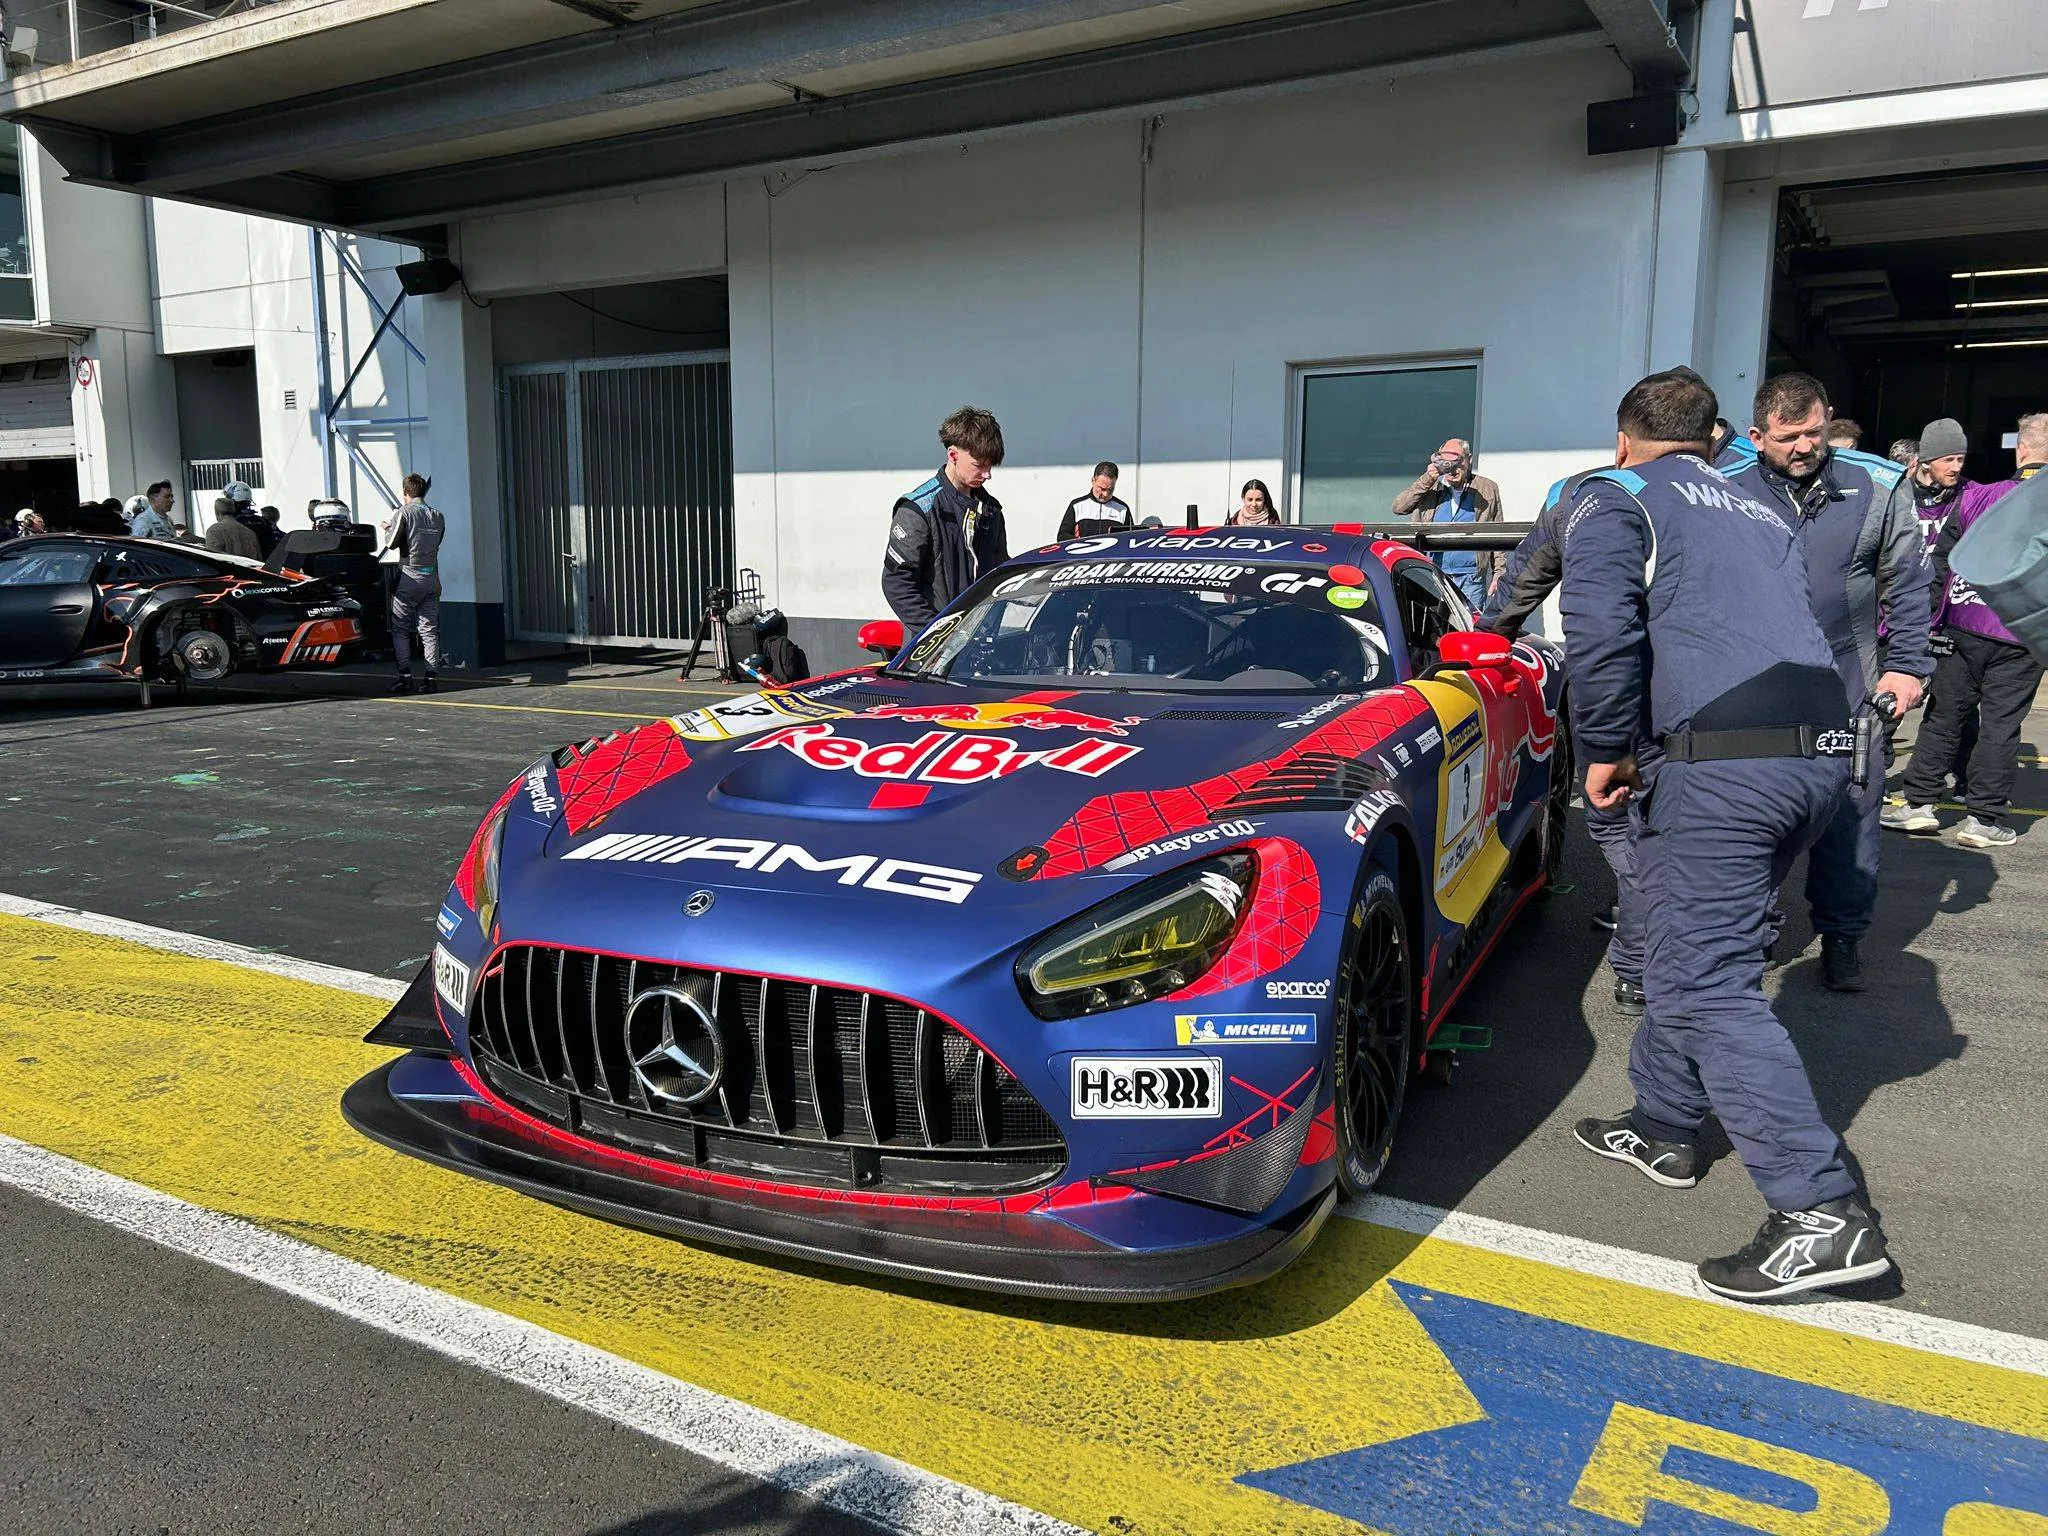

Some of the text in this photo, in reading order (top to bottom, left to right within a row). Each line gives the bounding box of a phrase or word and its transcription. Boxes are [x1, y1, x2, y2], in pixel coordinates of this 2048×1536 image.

[1127, 535, 1293, 553] viaplay
[1050, 564, 1126, 582] GRAN
[1072, 577, 1103, 587] REAL
[1104, 577, 1155, 585] DRIVING
[1156, 577, 1231, 588] SIMULATOR
[910, 615, 963, 661] 3
[734, 722, 942, 780] Red
[1463, 762, 1471, 821] 3
[1344, 789, 1409, 845] FALKE
[1134, 827, 1221, 863] Player
[660, 837, 984, 905] AMG
[1224, 1024, 1307, 1036] MICHELIN
[1079, 1068, 1164, 1108] H&R
